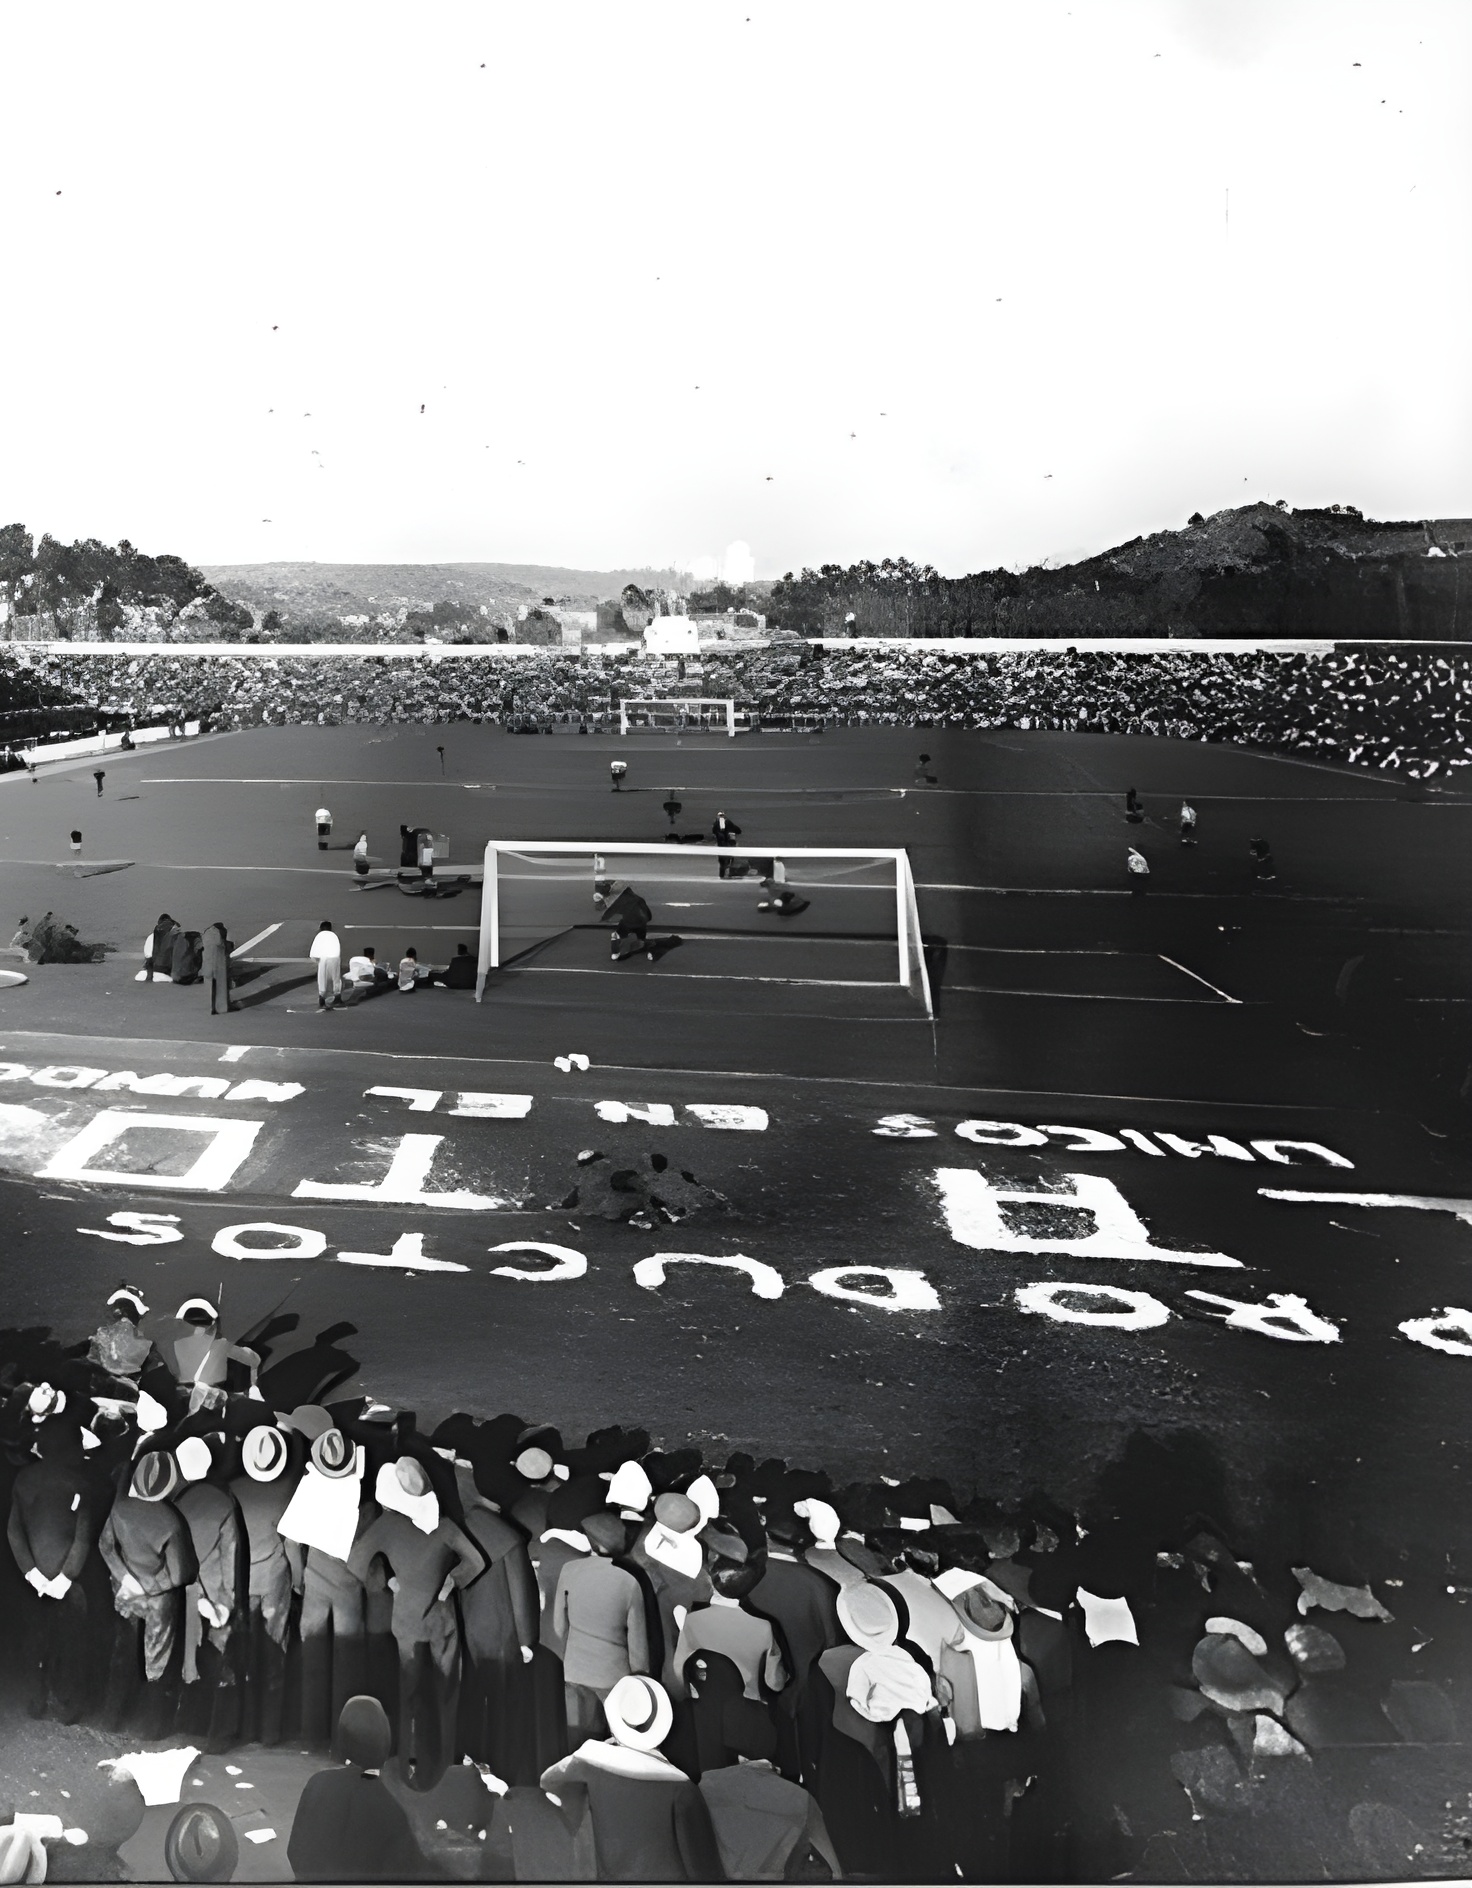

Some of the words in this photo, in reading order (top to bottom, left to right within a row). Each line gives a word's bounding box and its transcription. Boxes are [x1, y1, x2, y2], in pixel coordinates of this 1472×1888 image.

[362, 1086, 534, 1119] EL
[593, 1099, 769, 1131] EN
[871, 1113, 1355, 1169] UNICOS
[77, 1211, 1472, 1356] PRODUCTOS
